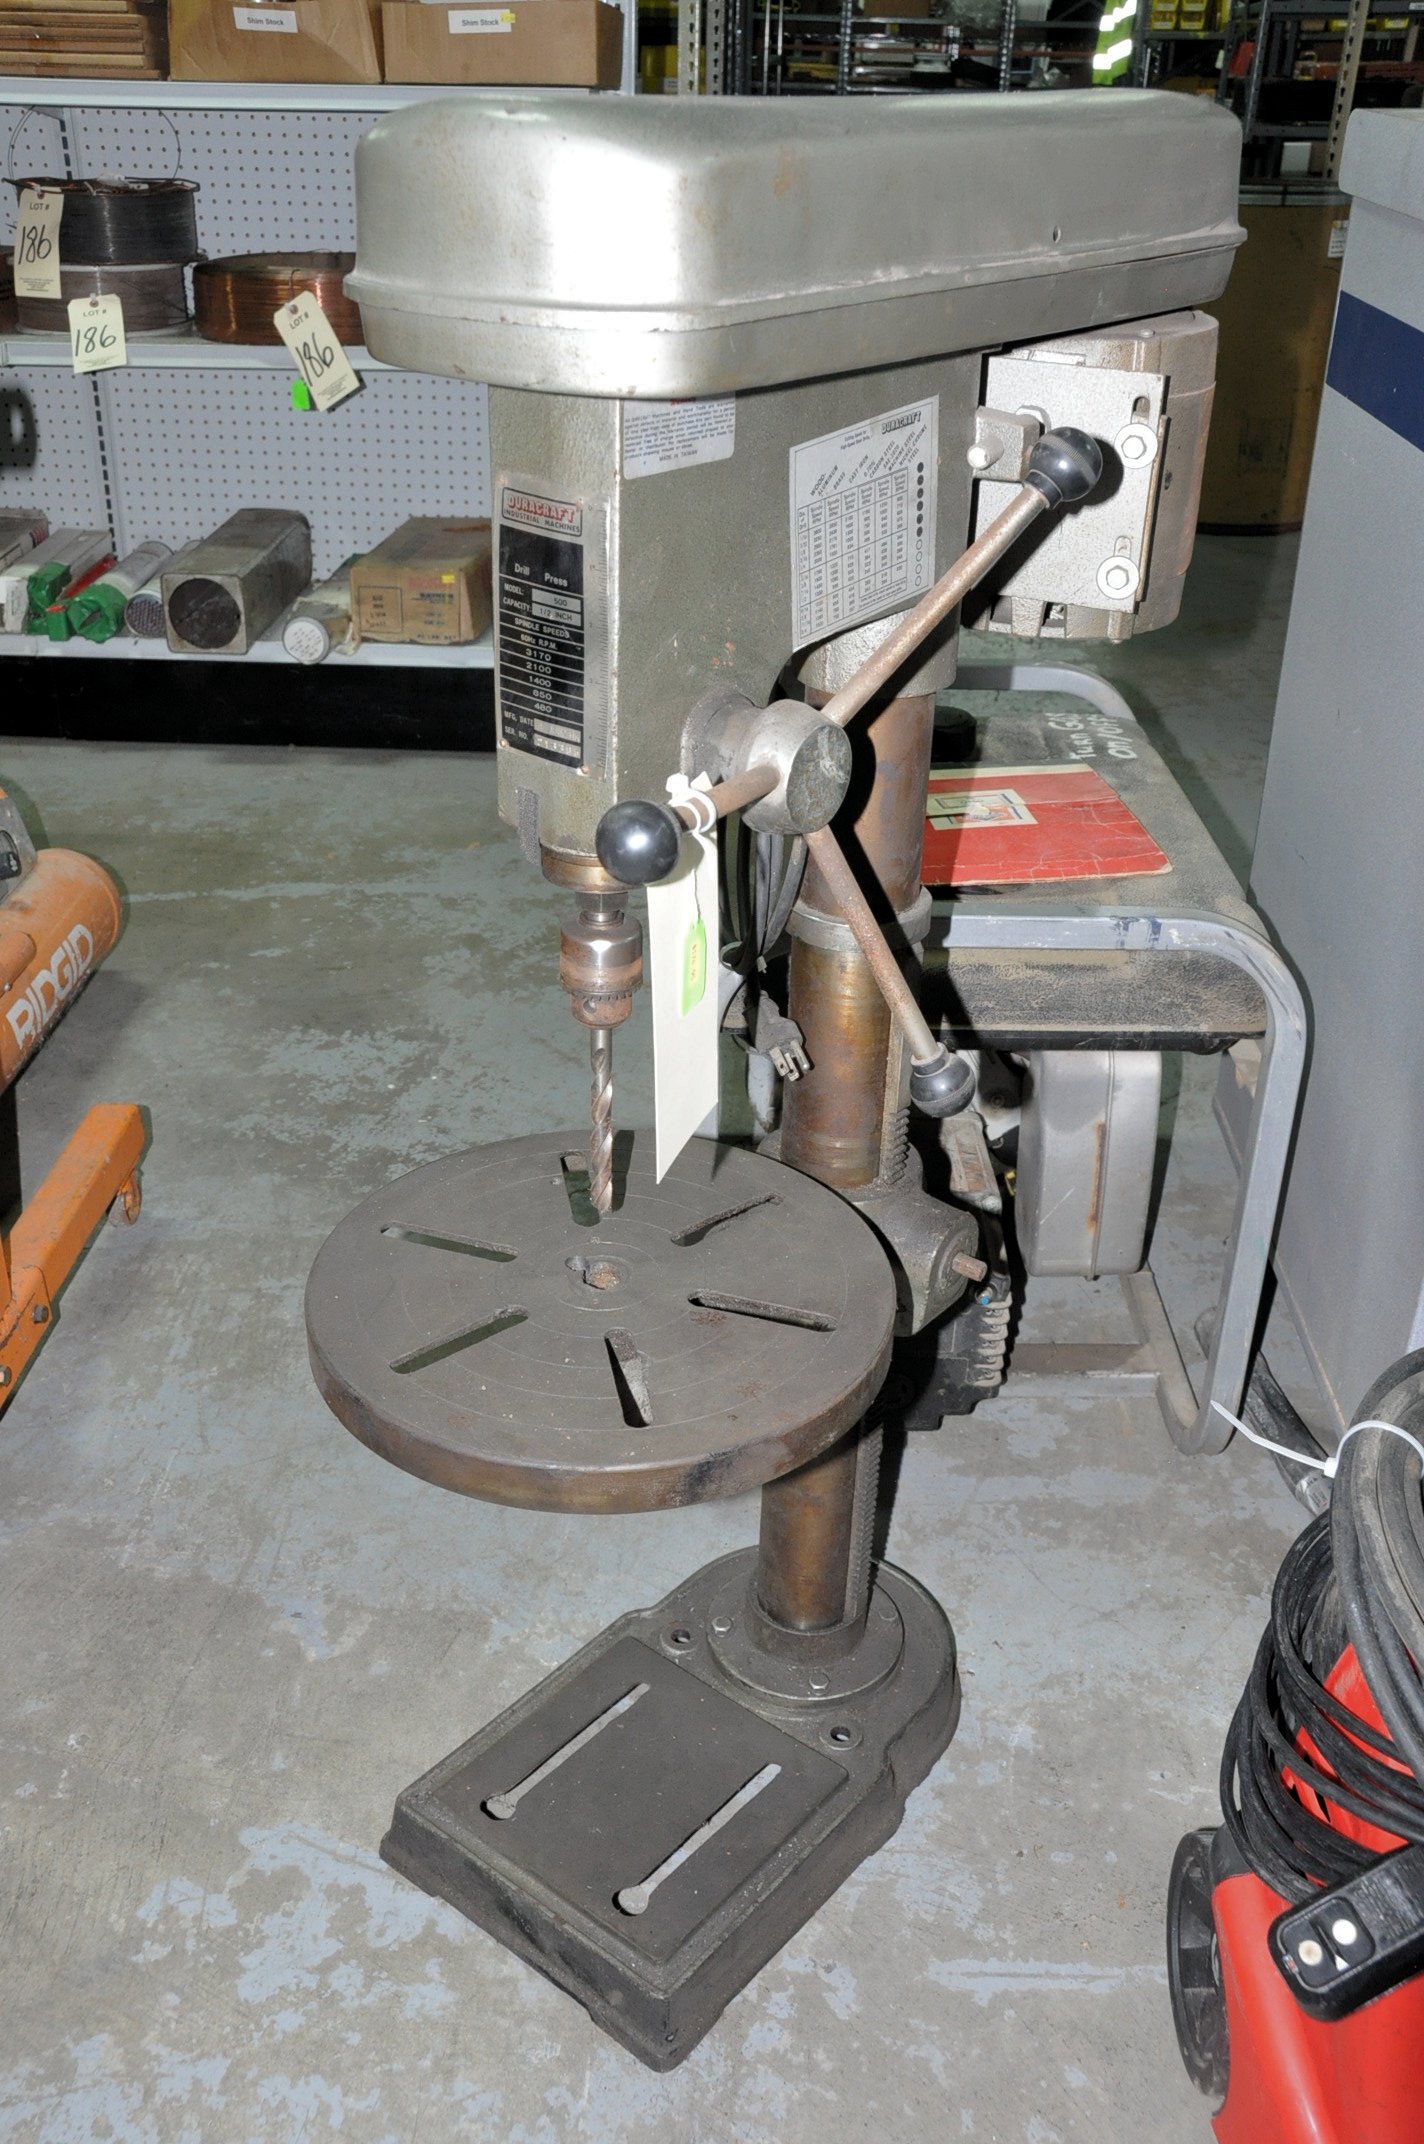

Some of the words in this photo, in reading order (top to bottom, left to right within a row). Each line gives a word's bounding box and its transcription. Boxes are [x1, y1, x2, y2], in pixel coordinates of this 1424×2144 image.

[18, 224, 52, 265] 186
[289, 315, 304, 330] LOT
[75, 324, 117, 357] 186
[295, 332, 334, 387] 186
[882, 410, 921, 435] DURACRAFT
[508, 494, 576, 523] DURACRAFT
[504, 508, 539, 524] INDUSTRIAL
[544, 520, 580, 533] MACHINES
[515, 563, 530, 576] Drill
[544, 572, 568, 587] Press
[504, 583, 524, 595] MODEL:
[554, 597, 568, 606] 500
[503, 597, 532, 612] CAPACITY:
[540, 608, 550, 616] 1/2
[555, 612, 572, 621] INCH
[515, 618, 539, 631] SPINDLE
[543, 626, 570, 638] SPEEDS
[526, 648, 551, 661] 3170
[539, 639, 557, 650] R.P.M.
[526, 662, 552, 674] 2100
[529, 676, 552, 687] 1400
[533, 689, 552, 700] 850
[505, 726, 516, 735] SER.
[519, 731, 528, 740] NO.
[6, 923, 94, 1050] RIDGID
